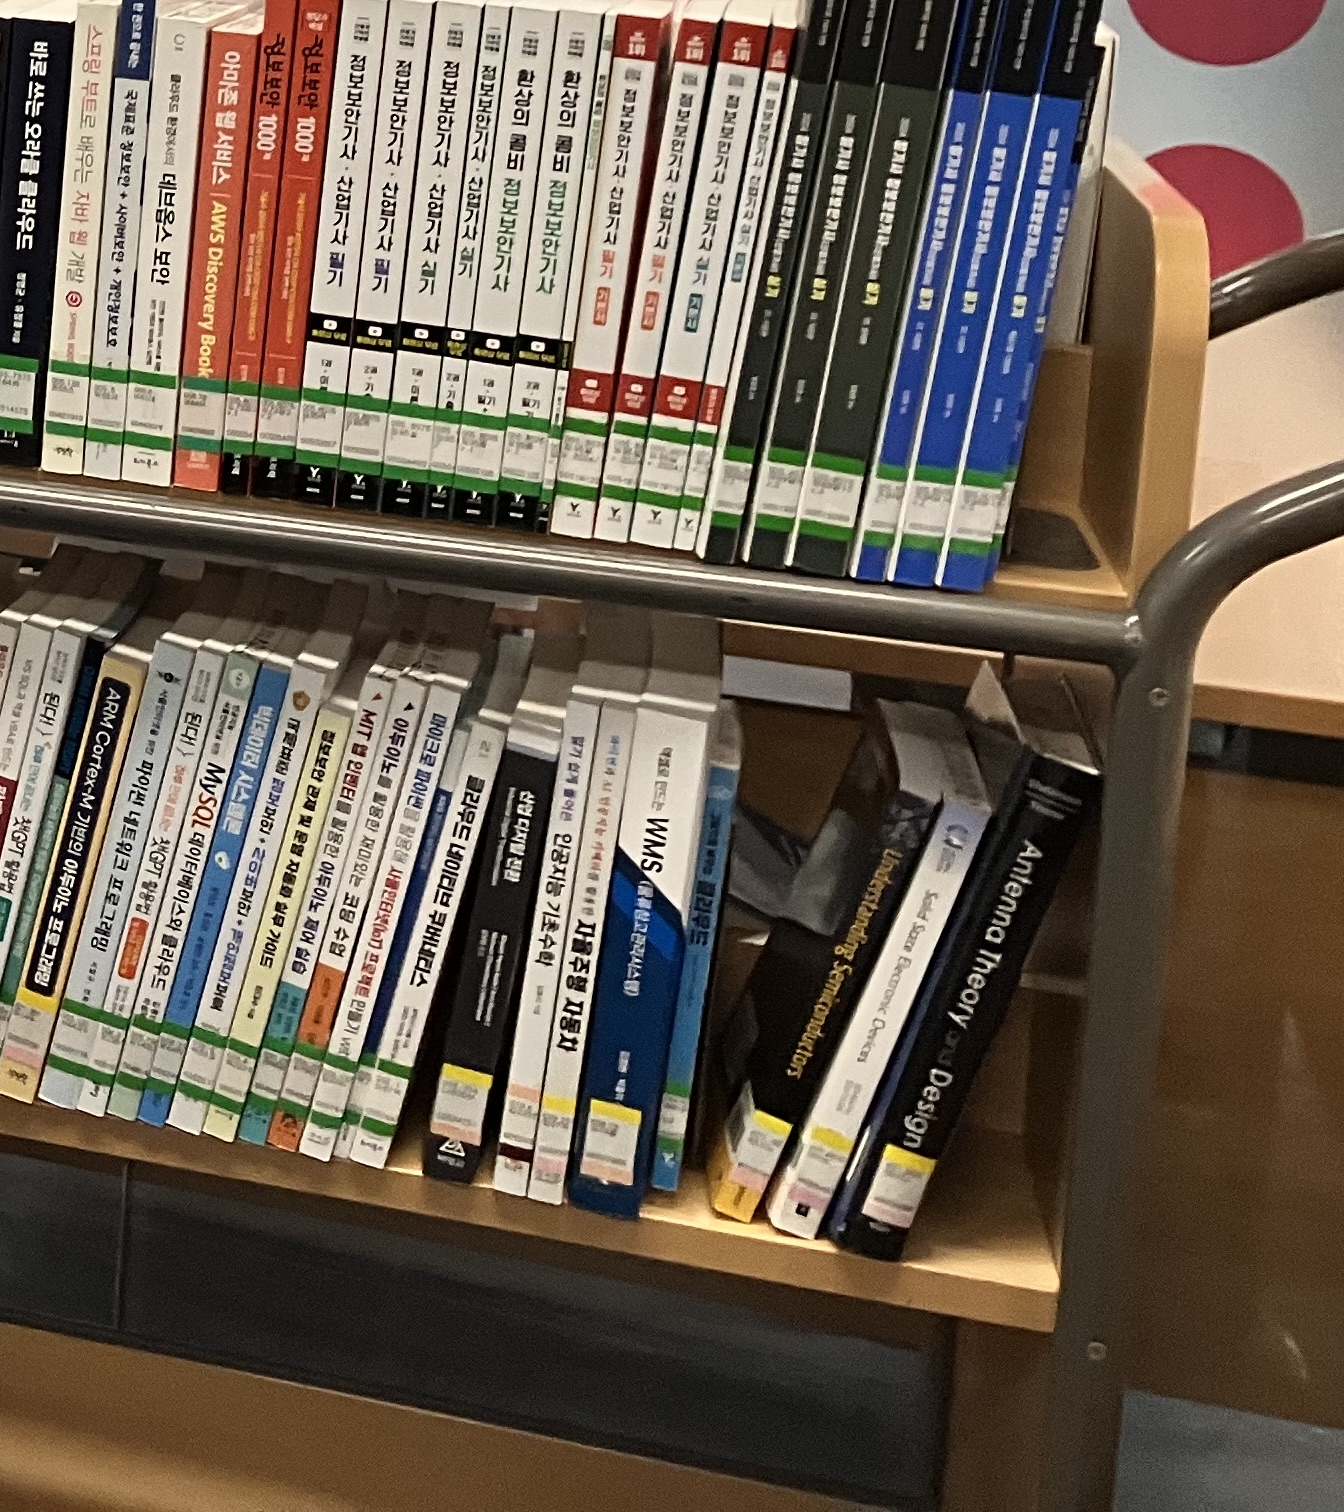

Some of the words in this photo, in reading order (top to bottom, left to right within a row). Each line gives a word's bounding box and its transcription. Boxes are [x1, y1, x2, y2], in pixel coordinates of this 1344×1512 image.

[25, 40, 49, 78] 바로
[80, 23, 104, 75] 스프링
[22, 80, 46, 118] 쓰는
[76, 79, 99, 130] 부트로
[215, 50, 242, 107] 아마존
[509, 67, 536, 127] 환상의
[555, 68, 583, 129] 환상의
[120, 88, 139, 136] 국제표준
[214, 109, 237, 129] 웹
[18, 120, 43, 175] 오라클
[72, 134, 95, 185] 배우는
[116, 139, 135, 188] 정보보안
[209, 130, 235, 186] 서비스
[14, 178, 40, 251] 클라우드
[69, 189, 91, 223] 자바
[111, 203, 130, 262] 사이버보안
[152, 172, 178, 243] 데브옵스
[208, 200, 227, 244] AWS
[330, 175, 354, 246] 산업기사
[374, 180, 399, 252] 산업기사
[421, 182, 448, 254] 산업기사
[491, 177, 524, 293] 정보보안기사
[68, 228, 88, 246] 웹
[535, 178, 569, 295] 정보보안기사
[65, 249, 87, 284] 개발
[150, 247, 173, 286] 보안
[197, 246, 224, 331] Discovery
[326, 251, 347, 287] 필기
[104, 278, 124, 348] 개인정보보호
[196, 333, 217, 379] Book
[94, 685, 123, 729] ARM
[237, 702, 275, 769] 빅데이터
[353, 707, 378, 742] MIT
[75, 728, 112, 810] Cortex-M
[374, 715, 410, 790] 아두이노를
[126, 758, 155, 807] 파이썬
[187, 760, 227, 832] MySQL
[450, 774, 486, 842] 클라우드
[5, 814, 32, 858] 챗GPT
[63, 809, 92, 856] 기반의
[109, 808, 143, 872] 네트워크
[140, 834, 172, 880] 챗GPT
[638, 815, 669, 873] WMS
[49, 857, 81, 915] 아두이노
[164, 829, 207, 933] 데이터베이스와
[306, 859, 337, 915] 아두이노
[431, 841, 467, 908] 네이티브
[543, 831, 572, 898] 인공지능
[982, 837, 1046, 948] Antenna
[89, 872, 126, 952] 프로그래밍
[337, 891, 362, 925] 코딩
[832, 843, 905, 964] Understanding
[31, 914, 67, 988] 프로그래밍
[149, 933, 180, 992] 클라우드
[257, 927, 283, 969] 가이드
[290, 945, 314, 976] 실습
[327, 924, 353, 959] 수업
[533, 900, 561, 967] 기초수학
[563, 918, 596, 993] 자율주행
[942, 942, 1003, 1032] Theory
[553, 996, 584, 1053] 자동차
[783, 958, 855, 1083] Semiconductors
[893, 1062, 954, 1153] Design
